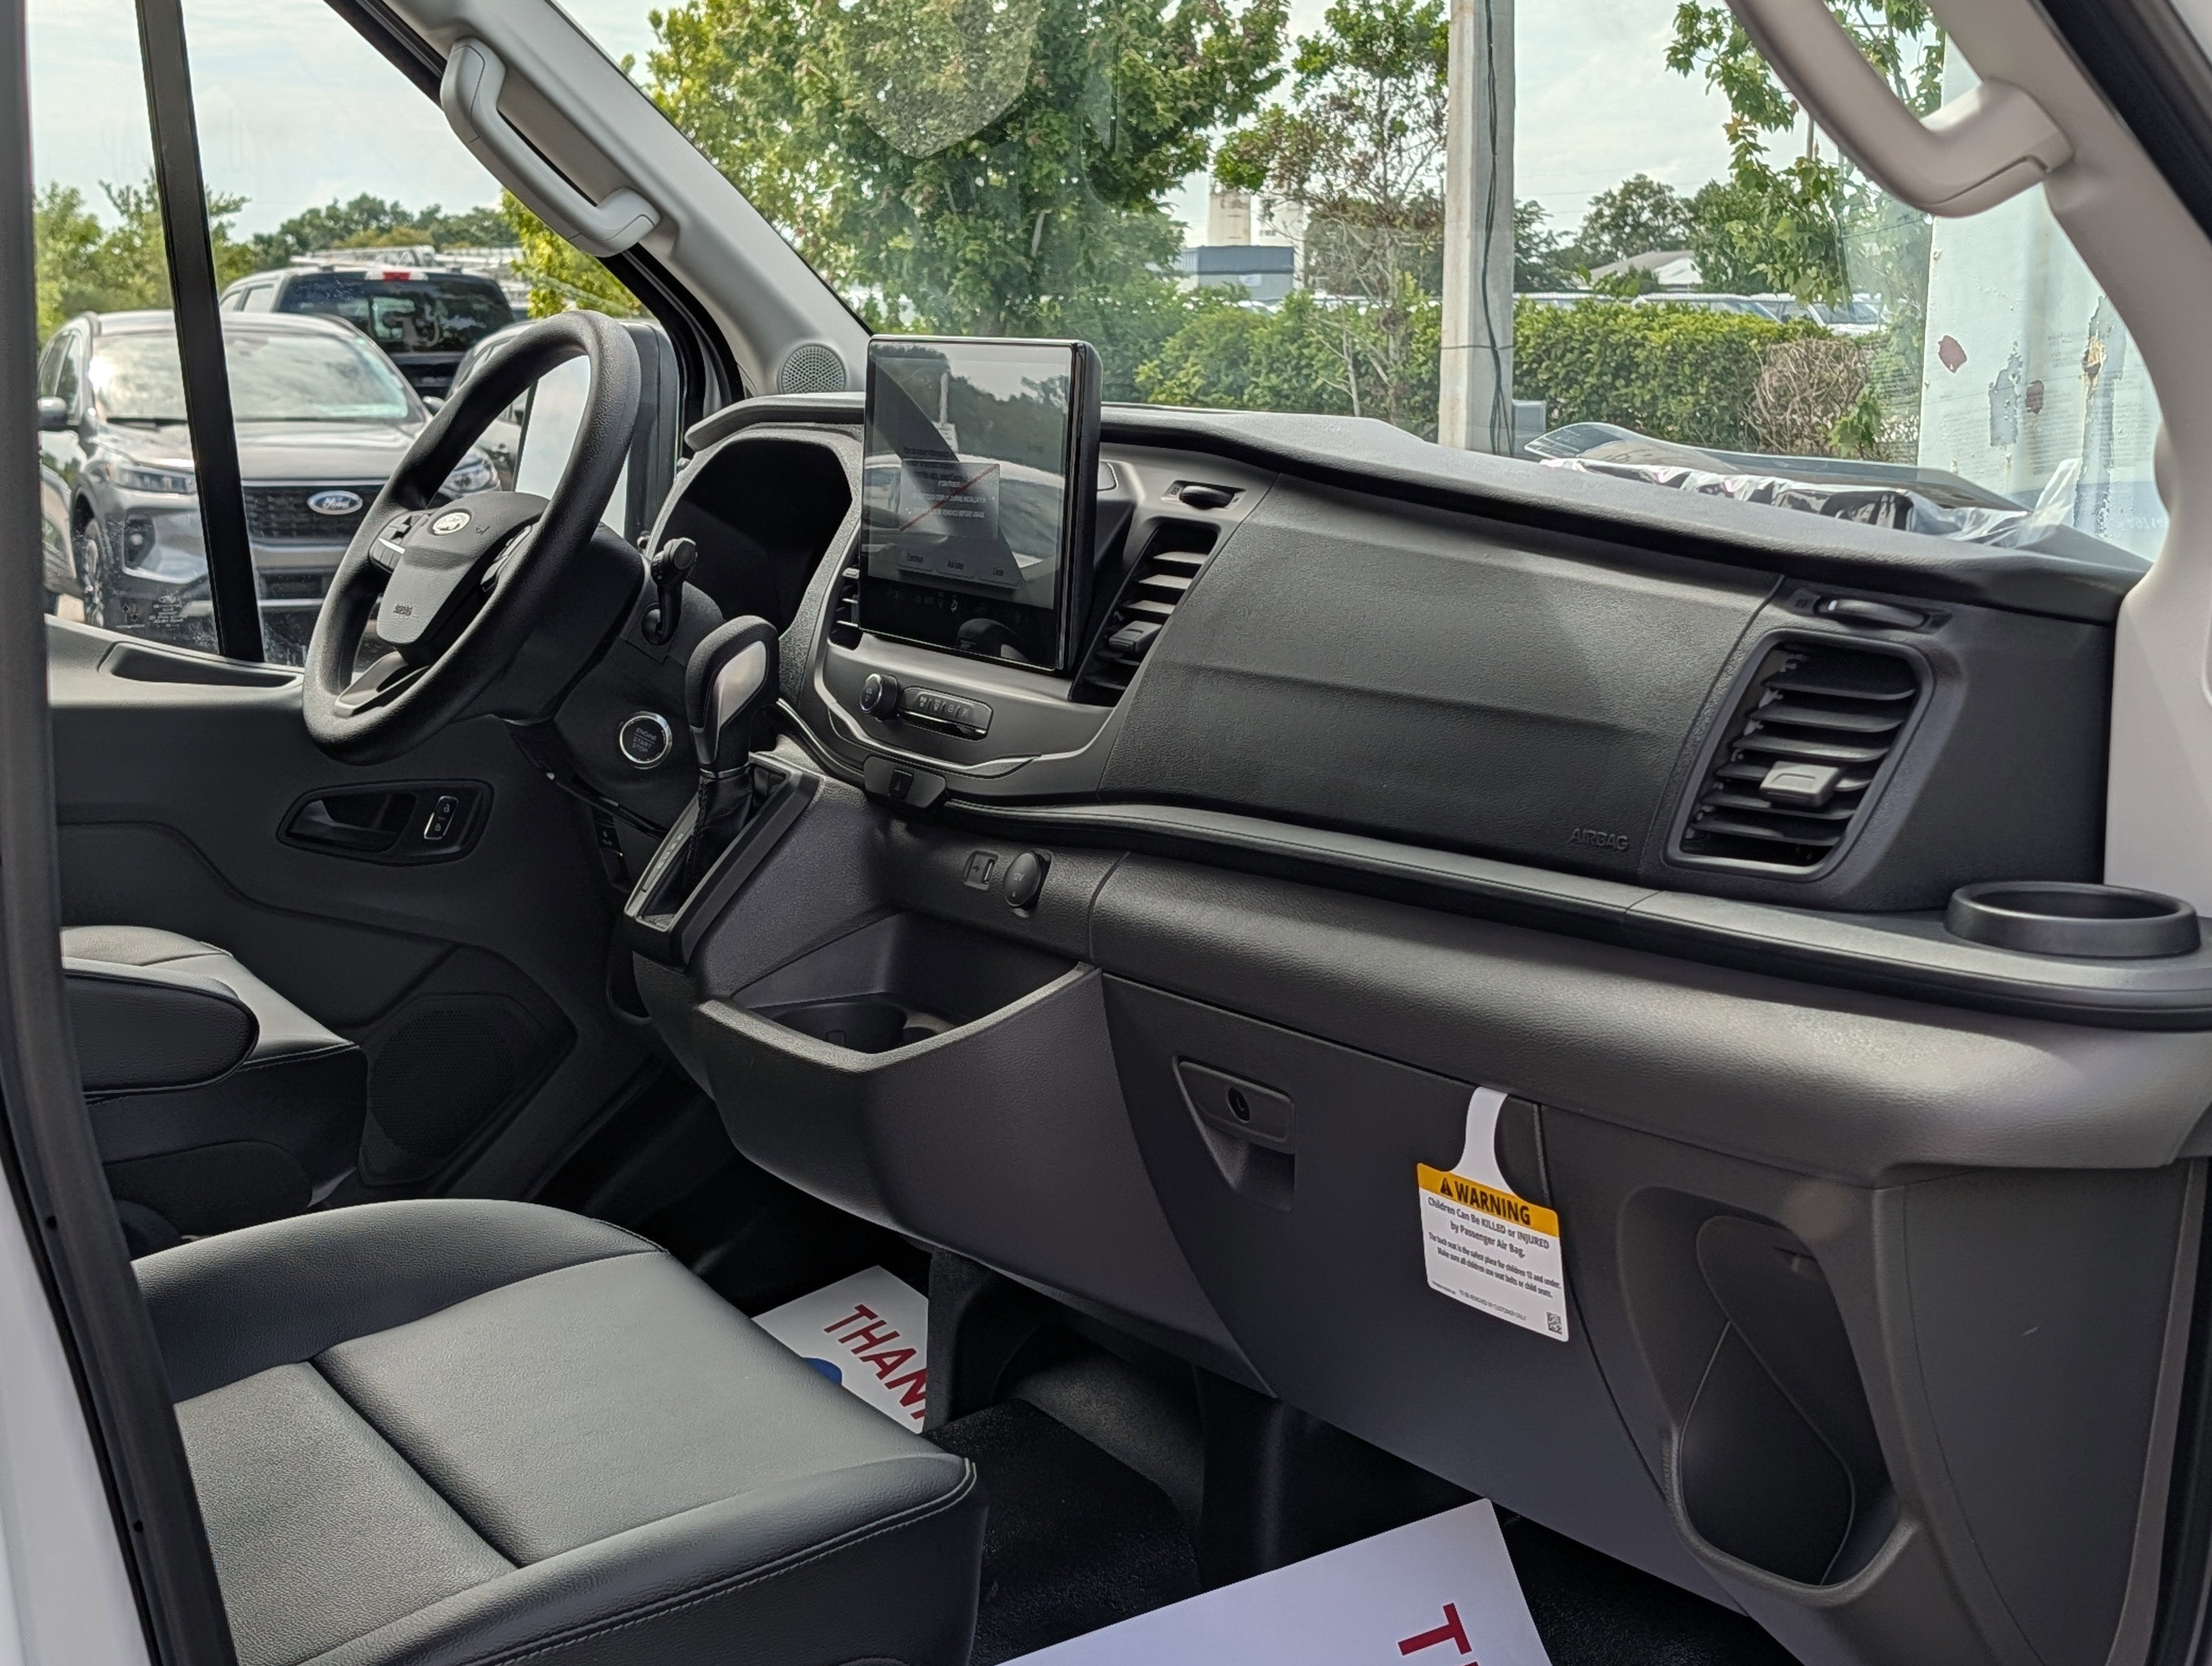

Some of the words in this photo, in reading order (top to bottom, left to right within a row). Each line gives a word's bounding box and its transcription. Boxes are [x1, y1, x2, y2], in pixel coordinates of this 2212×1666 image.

[631, 742, 649, 752] STOP
[632, 736, 652, 749] START
[635, 727, 657, 741] ENGINE
[1570, 828, 1629, 850] AIRBAG
[1428, 1196, 1455, 1215] Children
[1456, 1208, 1470, 1220] Can
[1471, 1214, 1480, 1225] Be
[1481, 1218, 1506, 1234] KILLED
[1508, 1229, 1515, 1237] or
[1517, 1231, 1549, 1249] INJURED
[1454, 1181, 1531, 1226] WARNING
[1429, 1232, 1437, 1242] The
[1437, 1236, 1447, 1246] back
[1448, 1241, 1457, 1250] seat
[1470, 1251, 1484, 1260] safest
[1484, 1255, 1496, 1266] place
[1497, 1259, 1505, 1269] for
[1506, 1265, 1526, 1277] children
[1526, 1271, 1533, 1279] 12
[1533, 1274, 1544, 1283] and
[1544, 1278, 1561, 1289] under.
[1450, 1220, 1459, 1233] by
[1460, 1225, 1496, 1245] Passenger
[1497, 1239, 1508, 1250] Air
[1509, 1243, 1525, 1258] Bag.
[1437, 1247, 1449, 1258] Make
[1450, 1254, 1459, 1263] sure
[1467, 1259, 1485, 1273] children
[1494, 1272, 1504, 1281] seat
[1505, 1274, 1517, 1285] belts
[1525, 1281, 1537, 1292] child
[1538, 1287, 1553, 1298] seats.
[824, 1304, 927, 1420] THAN
[1397, 1602, 1479, 1666] T
